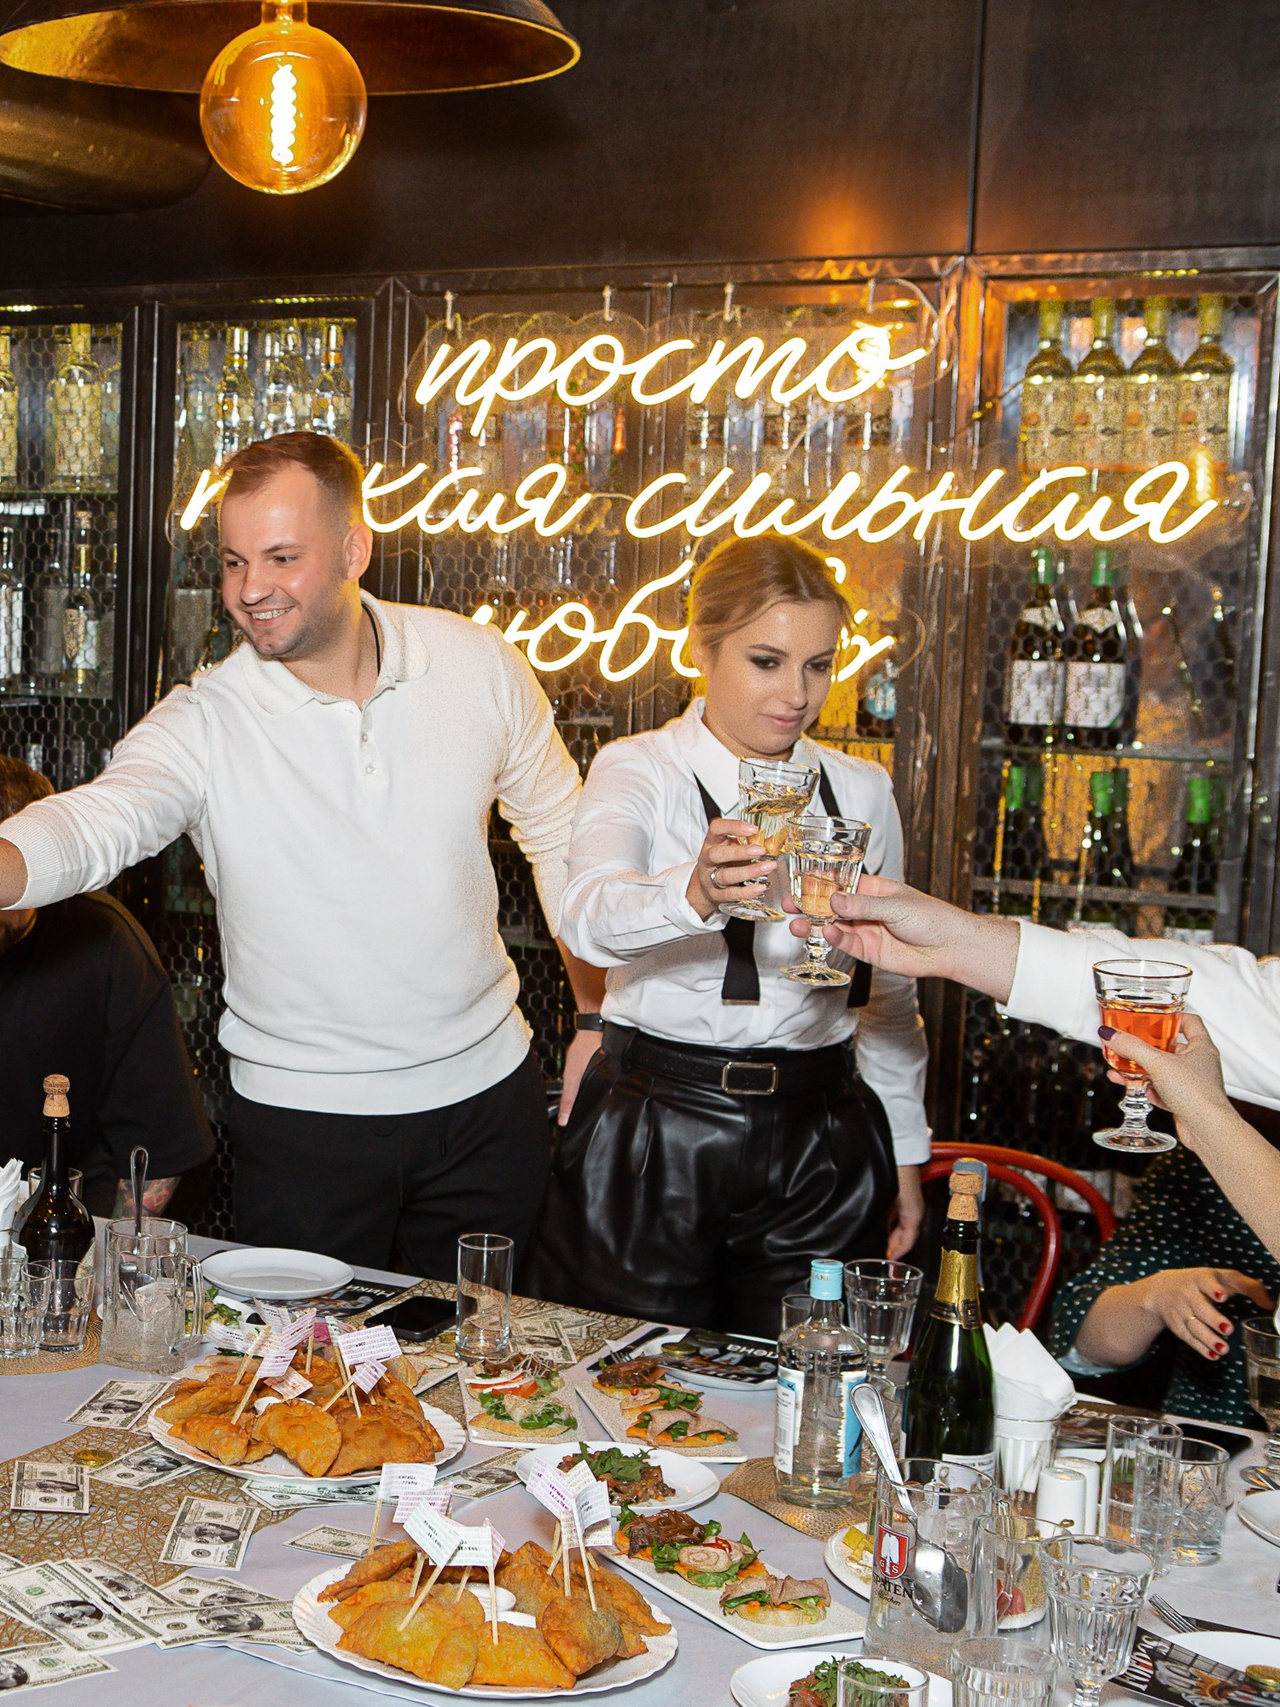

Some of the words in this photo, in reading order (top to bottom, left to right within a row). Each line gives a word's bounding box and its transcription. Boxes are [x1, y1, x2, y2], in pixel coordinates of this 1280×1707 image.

[415, 325, 927, 438] просто
[179, 455, 592, 538] кая
[626, 460, 1218, 543] сильная
[872, 1573, 914, 1600] SPATEN
[891, 1565, 899, 1574] S
